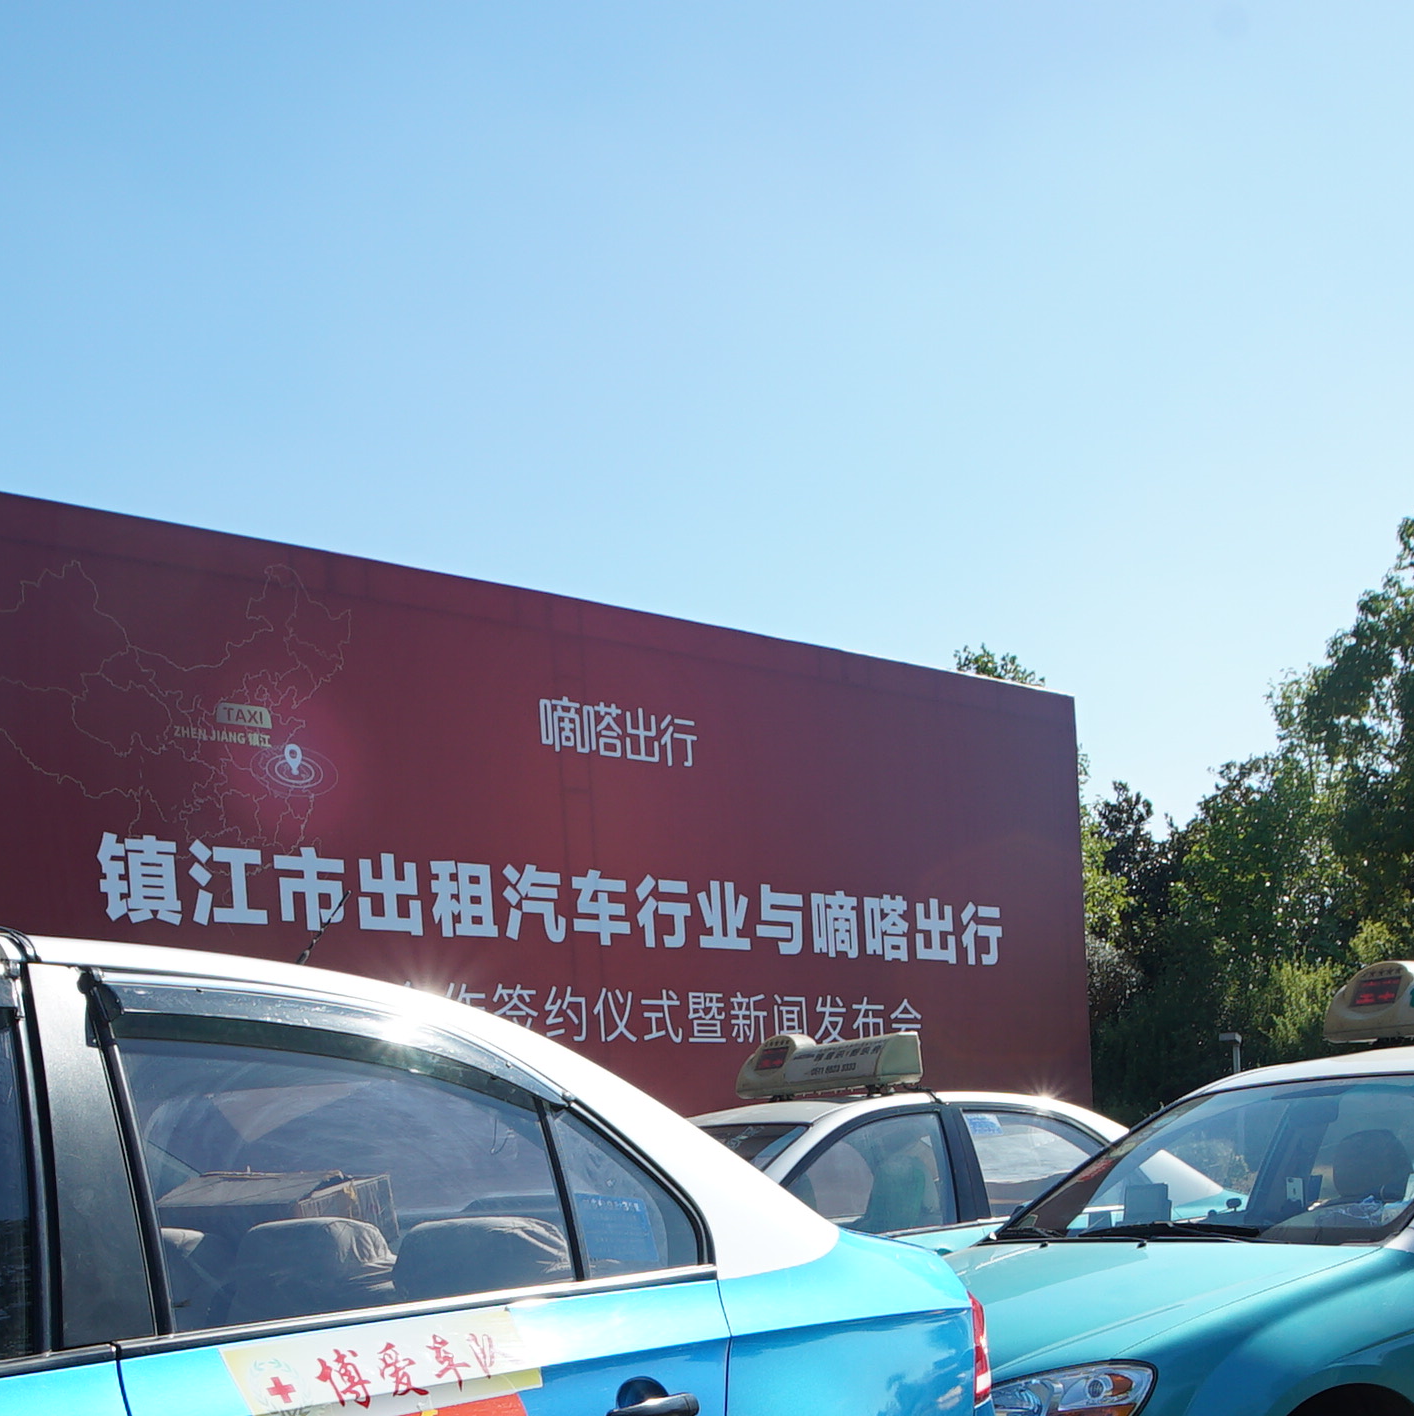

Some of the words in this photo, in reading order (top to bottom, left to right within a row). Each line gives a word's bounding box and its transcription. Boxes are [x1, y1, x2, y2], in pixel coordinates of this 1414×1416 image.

[173, 725, 206, 740] ZHEN
[209, 730, 246, 744] JIANG
[248, 732, 272, 748] 镇江
[223, 706, 264, 725] TAXI
[539, 694, 697, 769] 嘀嗒出行
[97, 829, 1004, 966] 镇江市出租汽车行业与嘀嗒出行
[404, 980, 922, 1045] 签约仪式暨新闻发布会
